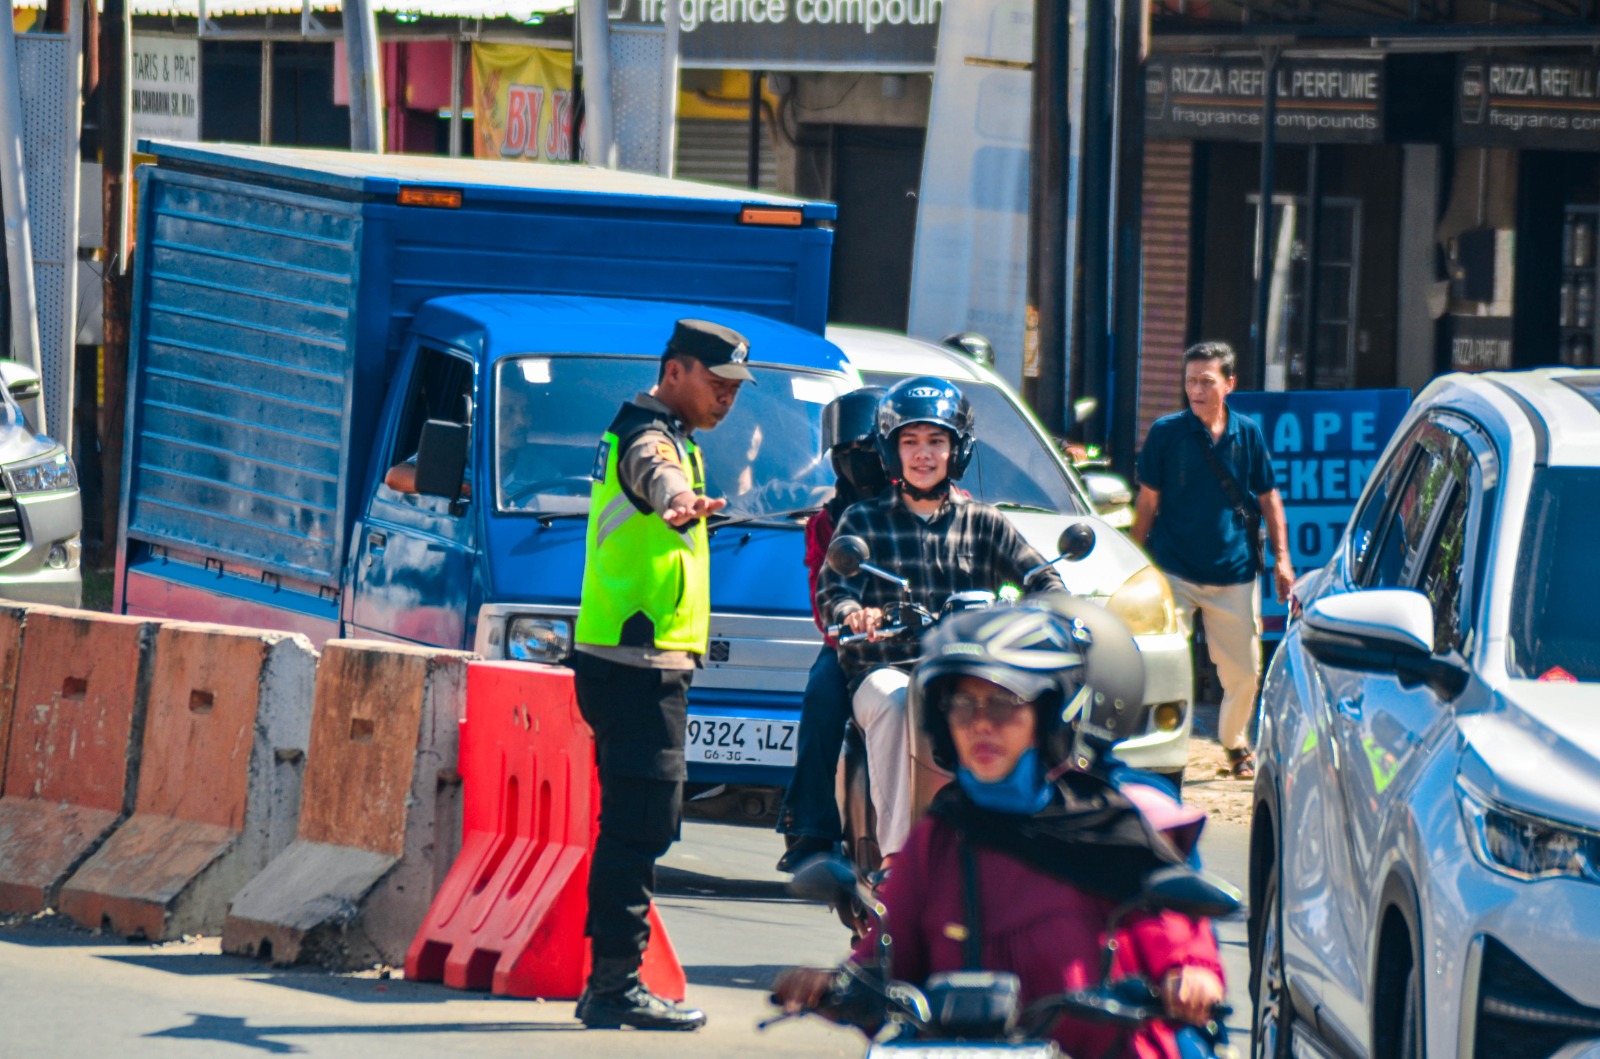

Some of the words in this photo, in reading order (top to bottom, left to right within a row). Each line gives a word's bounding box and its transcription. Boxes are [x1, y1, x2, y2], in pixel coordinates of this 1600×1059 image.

[133, 53, 158, 82] TARIS
[163, 55, 170, 82] &
[174, 56, 196, 83] PPAT
[1489, 67, 1537, 95] RIZZA
[1171, 67, 1221, 94] RIZZA
[1228, 69, 1287, 96] REFIL
[1292, 71, 1377, 99] PERFUME
[502, 83, 544, 158] BY
[1172, 107, 1260, 126] fragrance
[1274, 113, 1377, 130] ompounds
[1490, 110, 1566, 130] fragrance
[1249, 411, 1376, 453] APE
[688, 720, 745, 748] 9324
